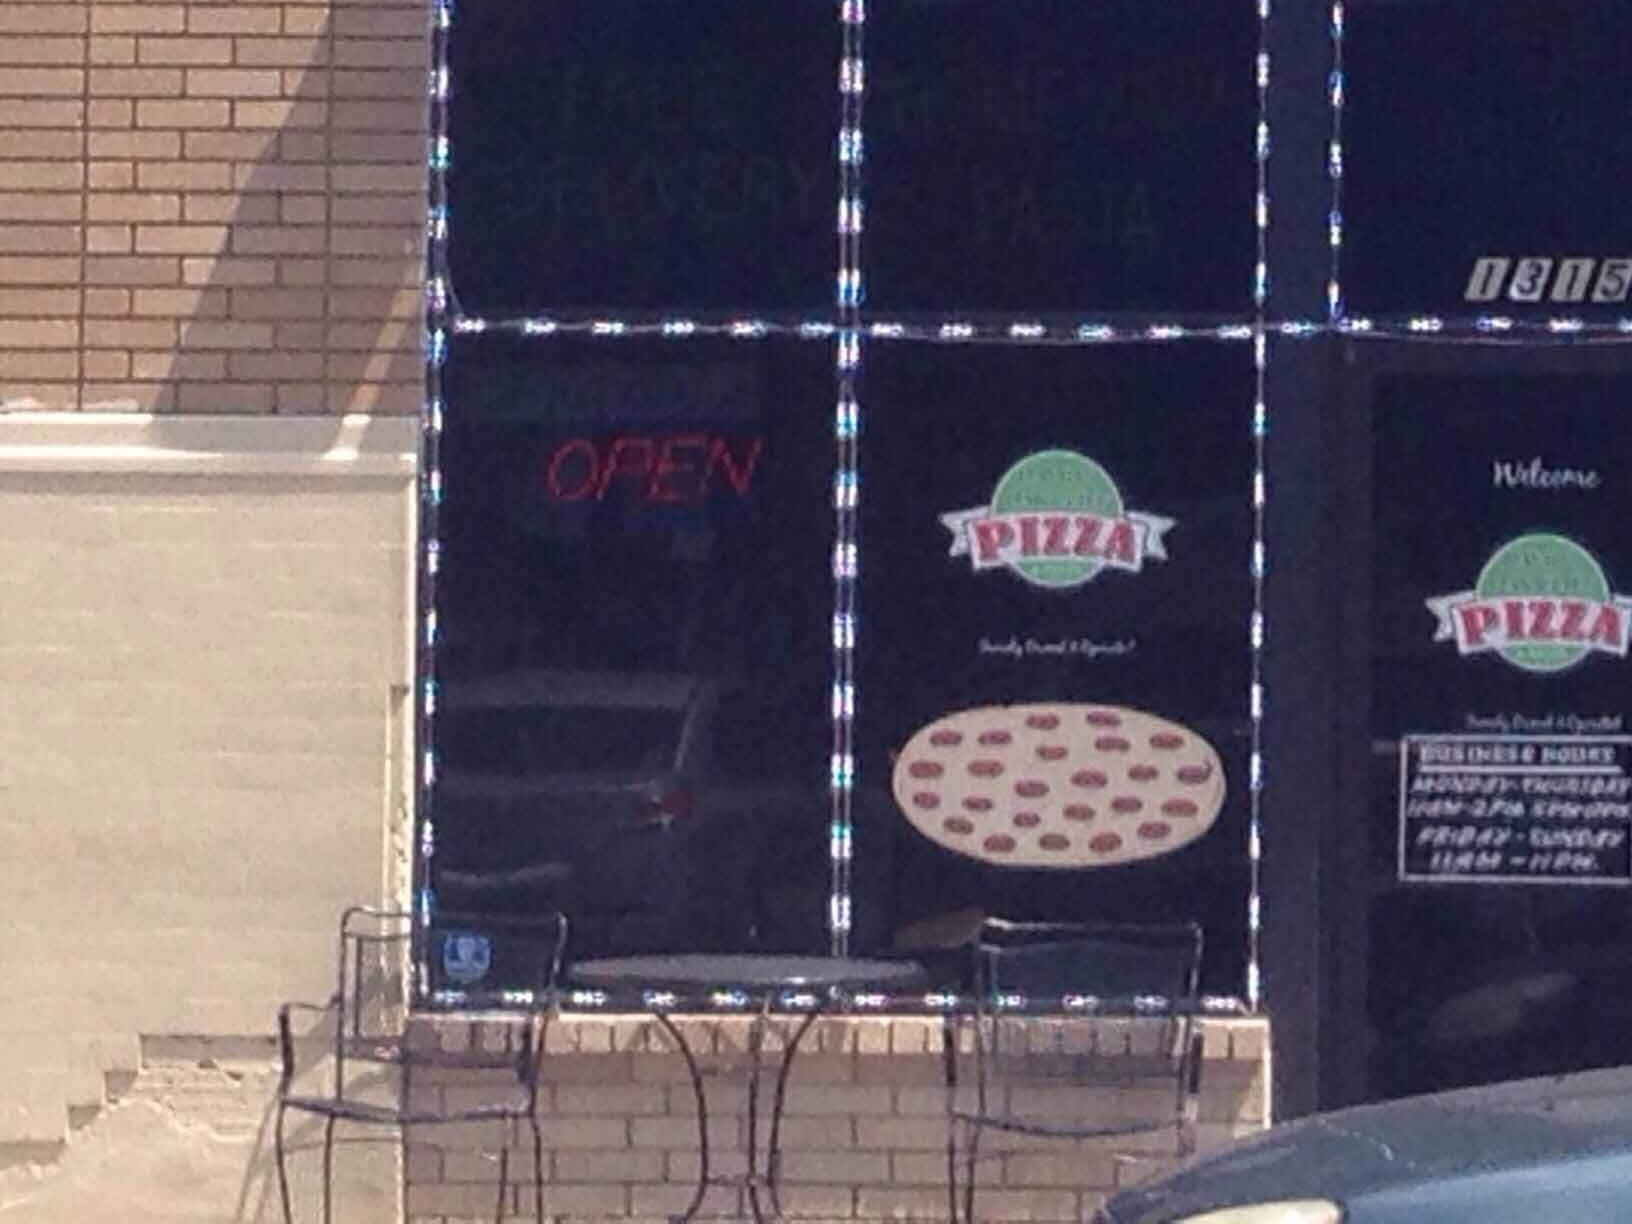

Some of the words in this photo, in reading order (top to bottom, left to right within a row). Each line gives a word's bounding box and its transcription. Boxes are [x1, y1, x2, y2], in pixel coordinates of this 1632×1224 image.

[547, 435, 763, 500] OPEN
[1492, 457, 1600, 489] Welcome
[974, 516, 1136, 562] PIZZA
[1460, 599, 1622, 647] PIZZA
